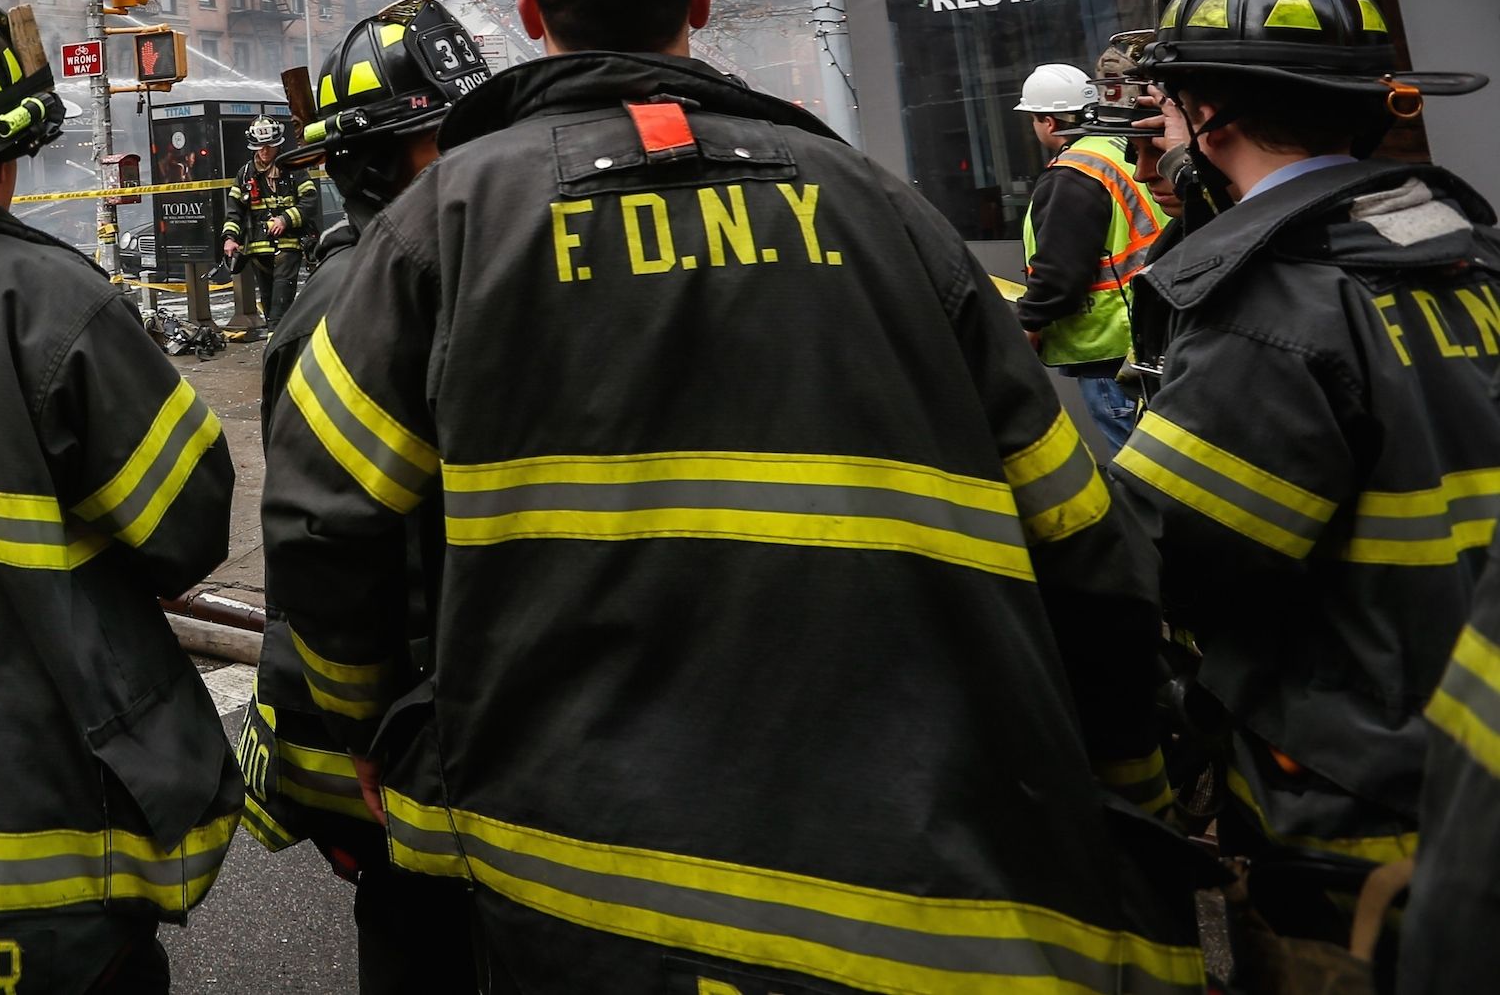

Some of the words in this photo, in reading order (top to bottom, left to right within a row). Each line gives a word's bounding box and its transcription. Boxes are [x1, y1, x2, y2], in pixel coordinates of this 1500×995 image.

[434, 33, 477, 70] 33
[67, 54, 97, 65] WRONG
[73, 64, 91, 73] WAY
[164, 107, 191, 117] TITAN
[275, 106, 289, 115] TITA
[162, 202, 204, 216] TODAY
